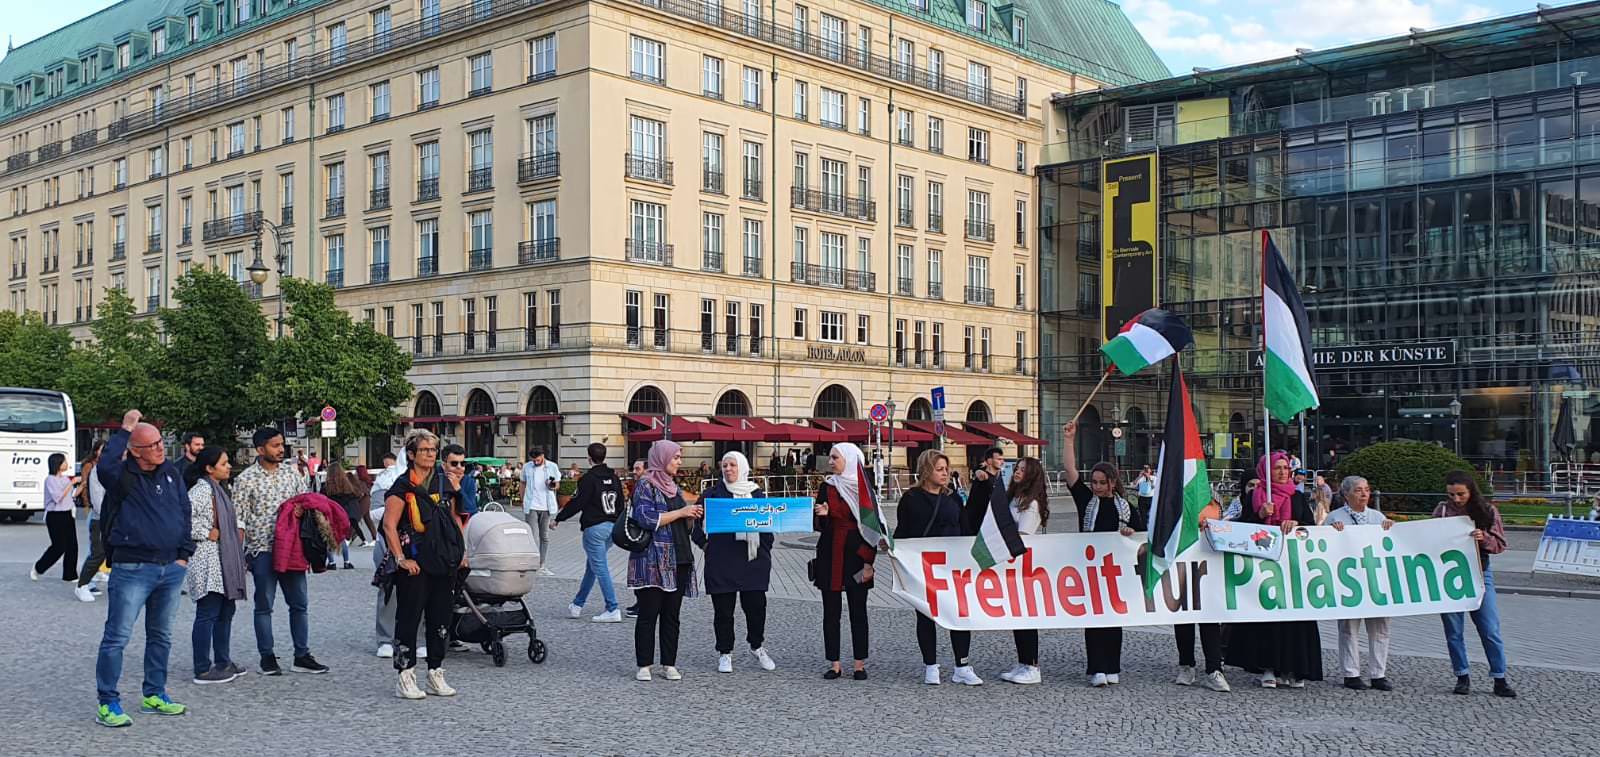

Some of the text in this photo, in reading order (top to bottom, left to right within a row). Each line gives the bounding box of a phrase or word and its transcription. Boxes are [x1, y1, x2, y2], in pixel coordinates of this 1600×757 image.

[807, 347, 865, 362] HOTEL ADLON
[1341, 350, 1374, 363] DER
[1379, 346, 1447, 362] KÜNSTE
[11, 452, 41, 465] irro
[921, 545, 1128, 617] Freiheit
[1223, 536, 1476, 611] Palästina
